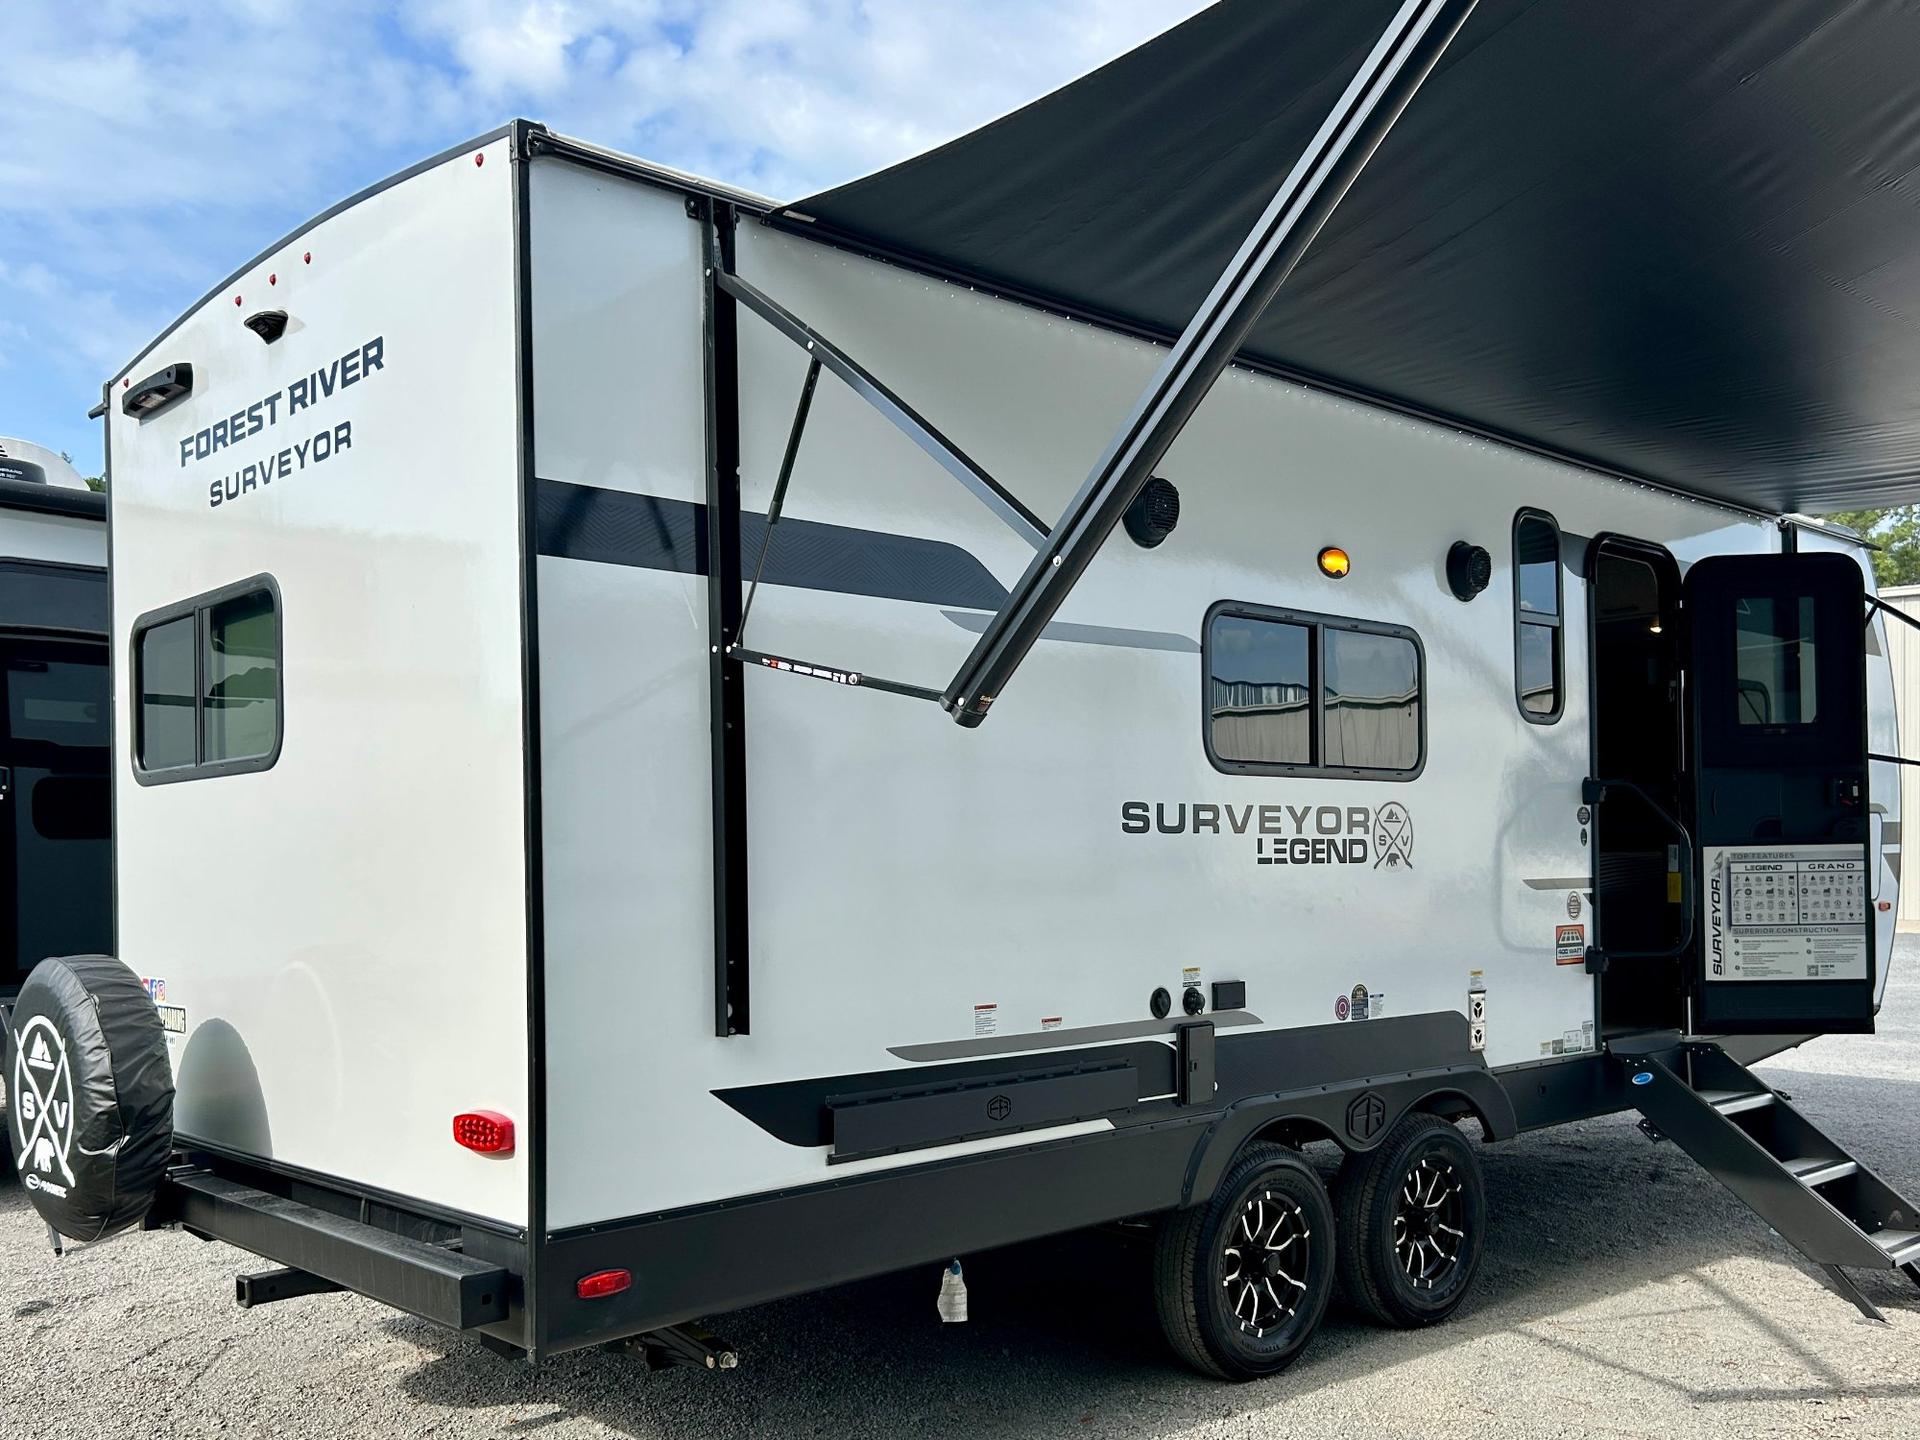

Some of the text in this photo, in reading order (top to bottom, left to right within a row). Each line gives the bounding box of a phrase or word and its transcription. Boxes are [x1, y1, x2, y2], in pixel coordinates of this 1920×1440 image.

[180, 336, 384, 467] FOREST RIVER
[210, 421, 352, 507] SURVEYOR
[1121, 801, 1370, 835] SURVEYOR
[1257, 838, 1368, 864] LEGEND
[1378, 834, 1410, 847] S V
[1711, 878, 1723, 976] SURVEYOR
[1734, 927, 1774, 935] SUPERIOR
[22, 1091, 68, 1128] S V
